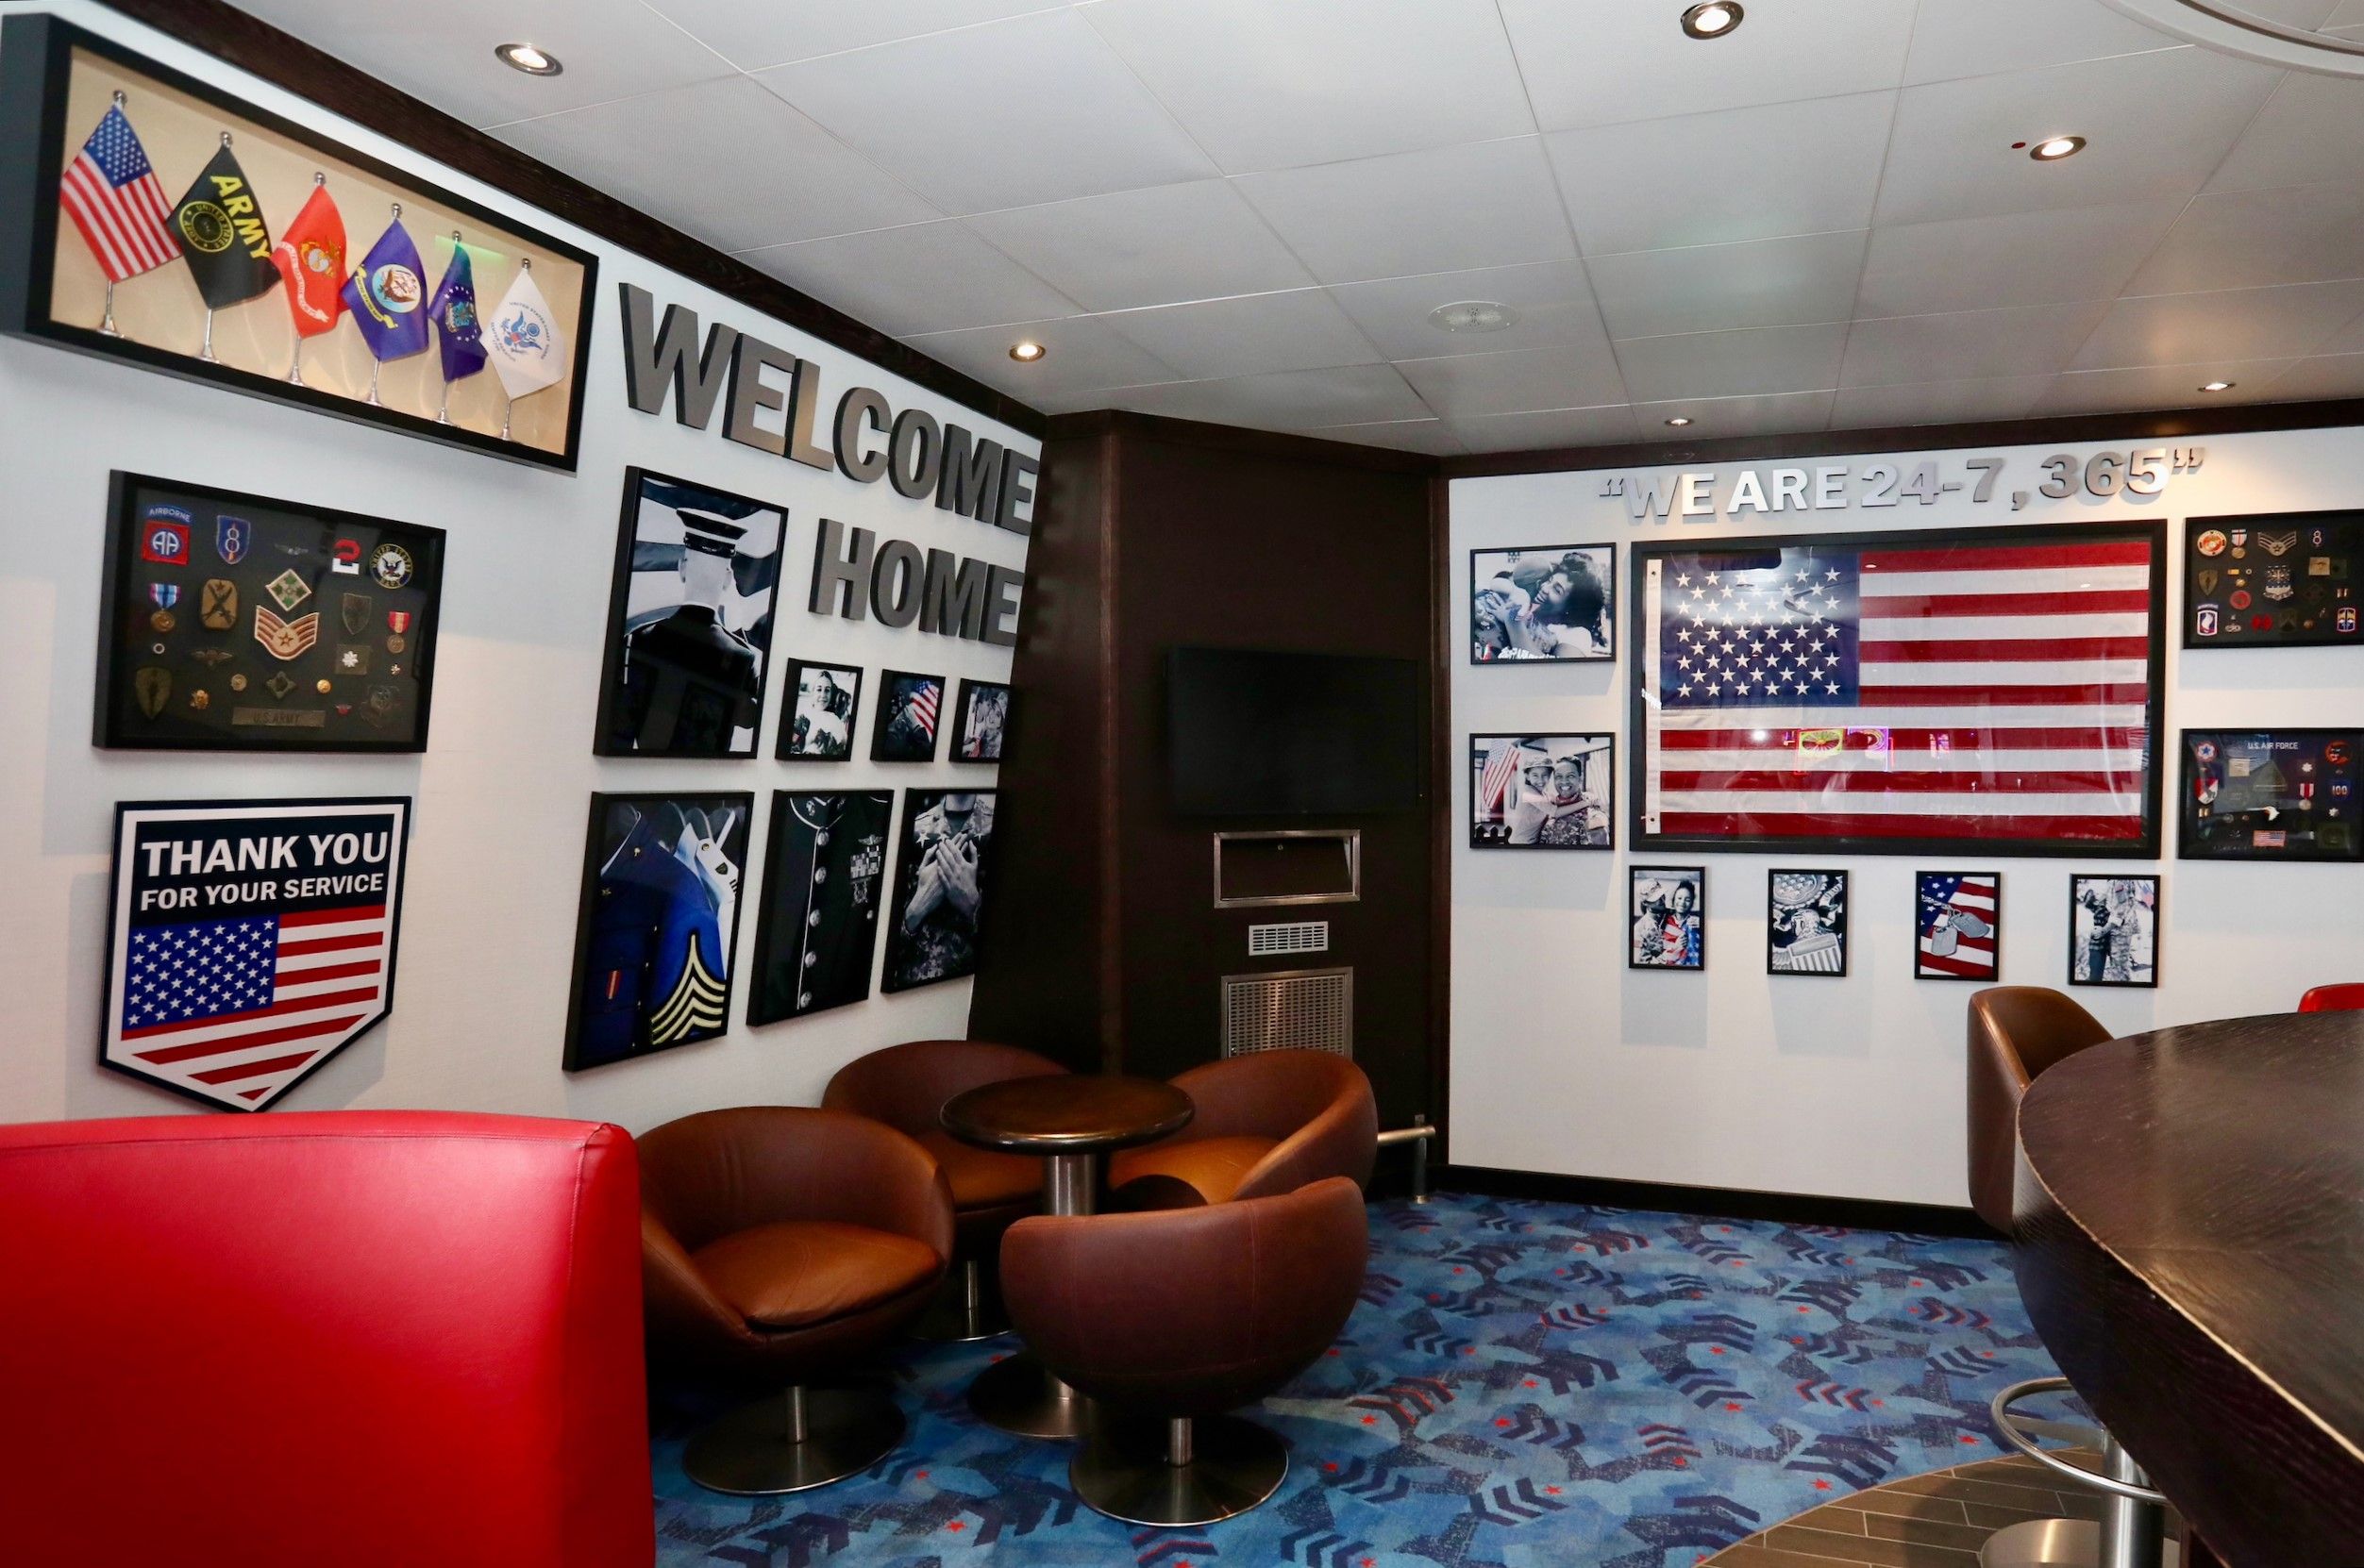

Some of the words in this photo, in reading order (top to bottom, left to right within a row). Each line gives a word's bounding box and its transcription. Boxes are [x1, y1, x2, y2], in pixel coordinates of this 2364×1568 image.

[210, 175, 272, 258] ARMY
[618, 282, 1039, 536] WELCOME
[1726, 466, 1848, 512] ARE
[149, 507, 191, 523] AIRBORNE
[808, 518, 1026, 647] HOME
[2275, 742, 2299, 750] FORCE
[142, 835, 300, 876] THANK
[308, 831, 388, 866] YOU
[140, 888, 197, 910] FOR
[205, 881, 277, 906] YOUR
[283, 873, 384, 898] SERVICE
